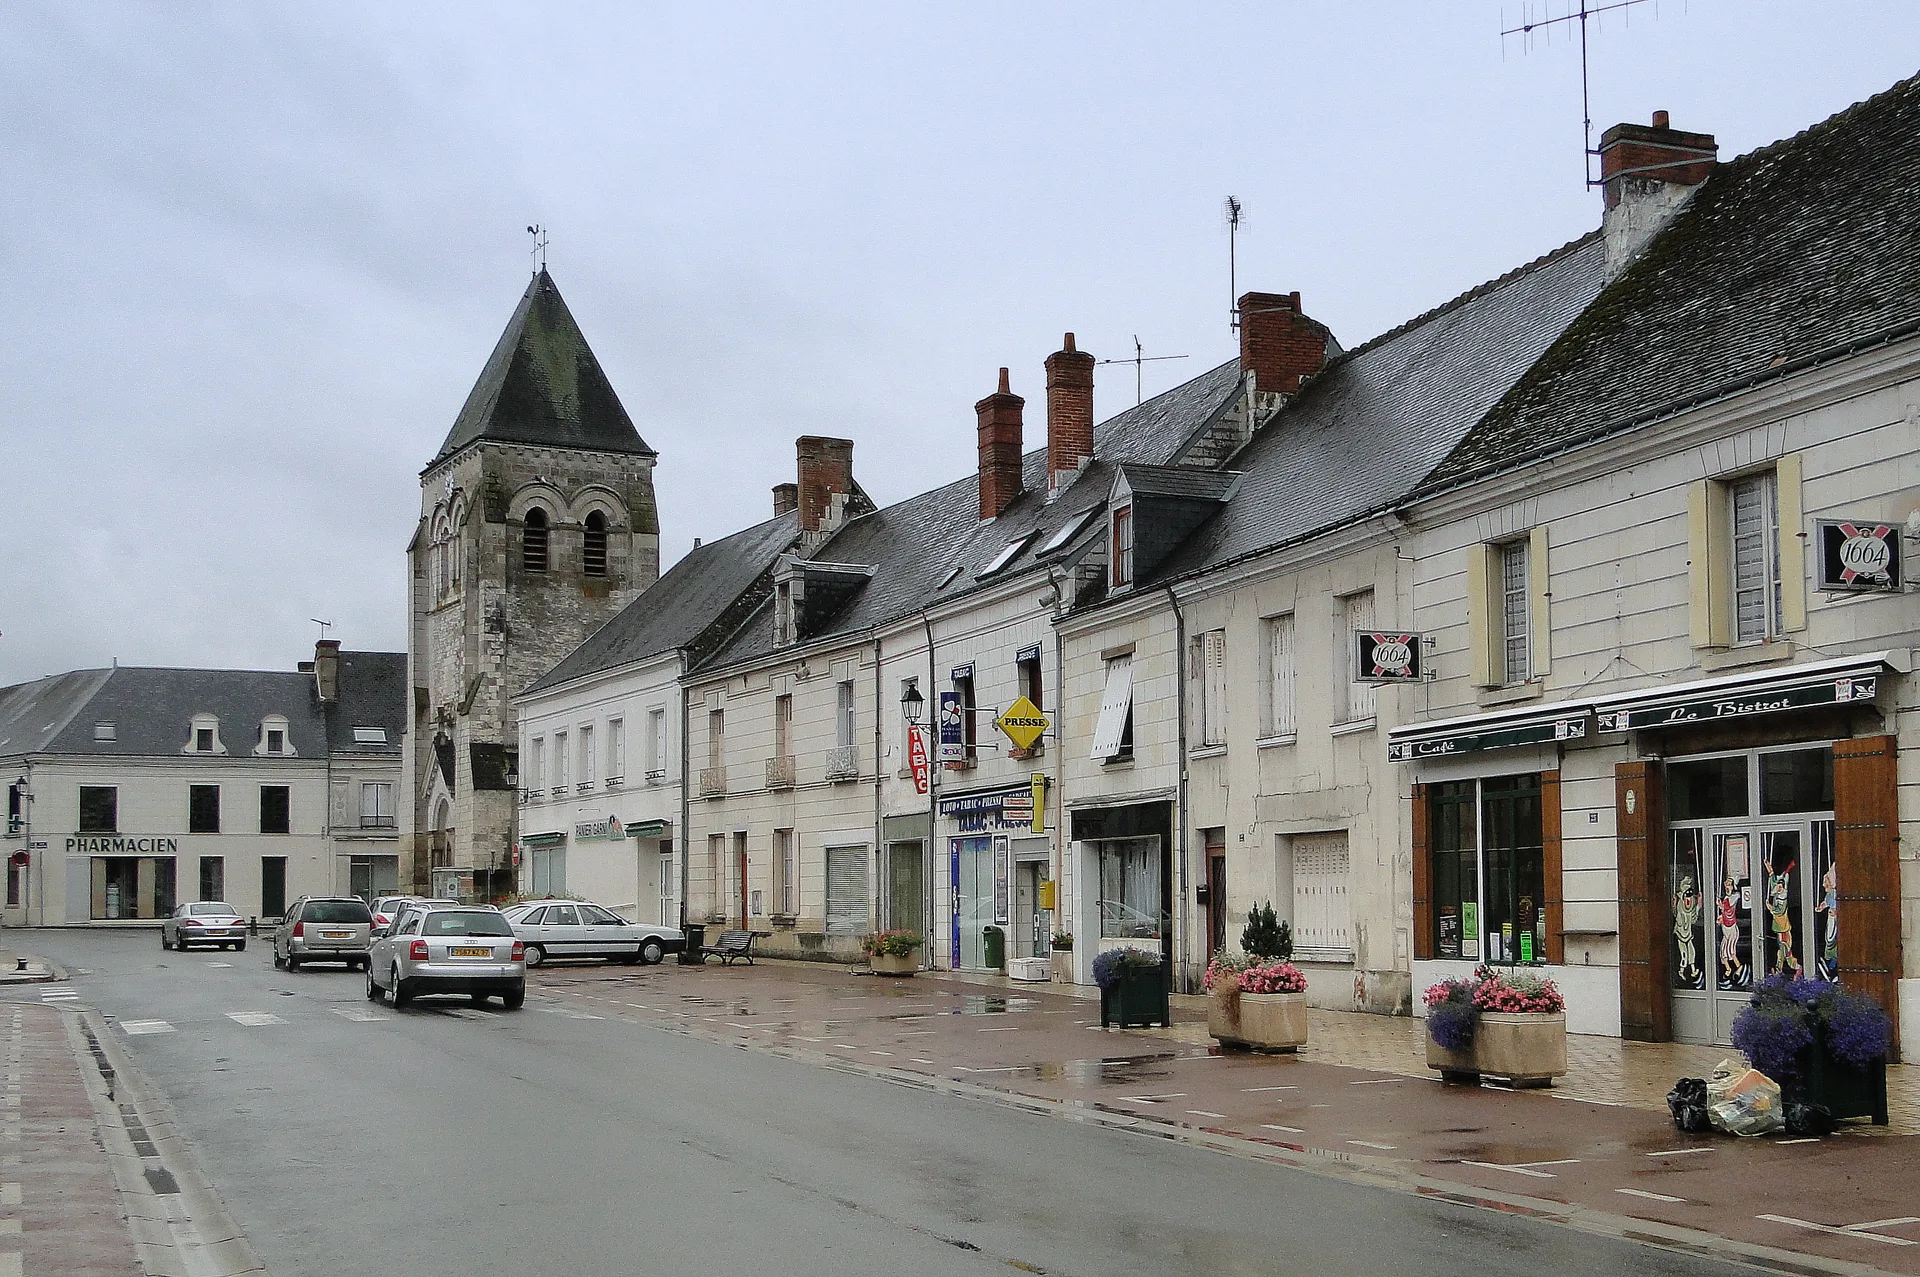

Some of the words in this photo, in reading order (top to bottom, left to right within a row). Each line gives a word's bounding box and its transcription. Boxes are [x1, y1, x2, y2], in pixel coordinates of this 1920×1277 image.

[1844, 540, 1887, 566] 1664
[1375, 646, 1409, 664] 1664
[1662, 708, 1697, 723] Le
[1712, 698, 1791, 716] Bistrot
[1004, 717, 1045, 727] PRESSE
[1419, 741, 1454, 754] Café
[911, 730, 927, 791] TABAC
[66, 838, 178, 852] PHARMACIEN
